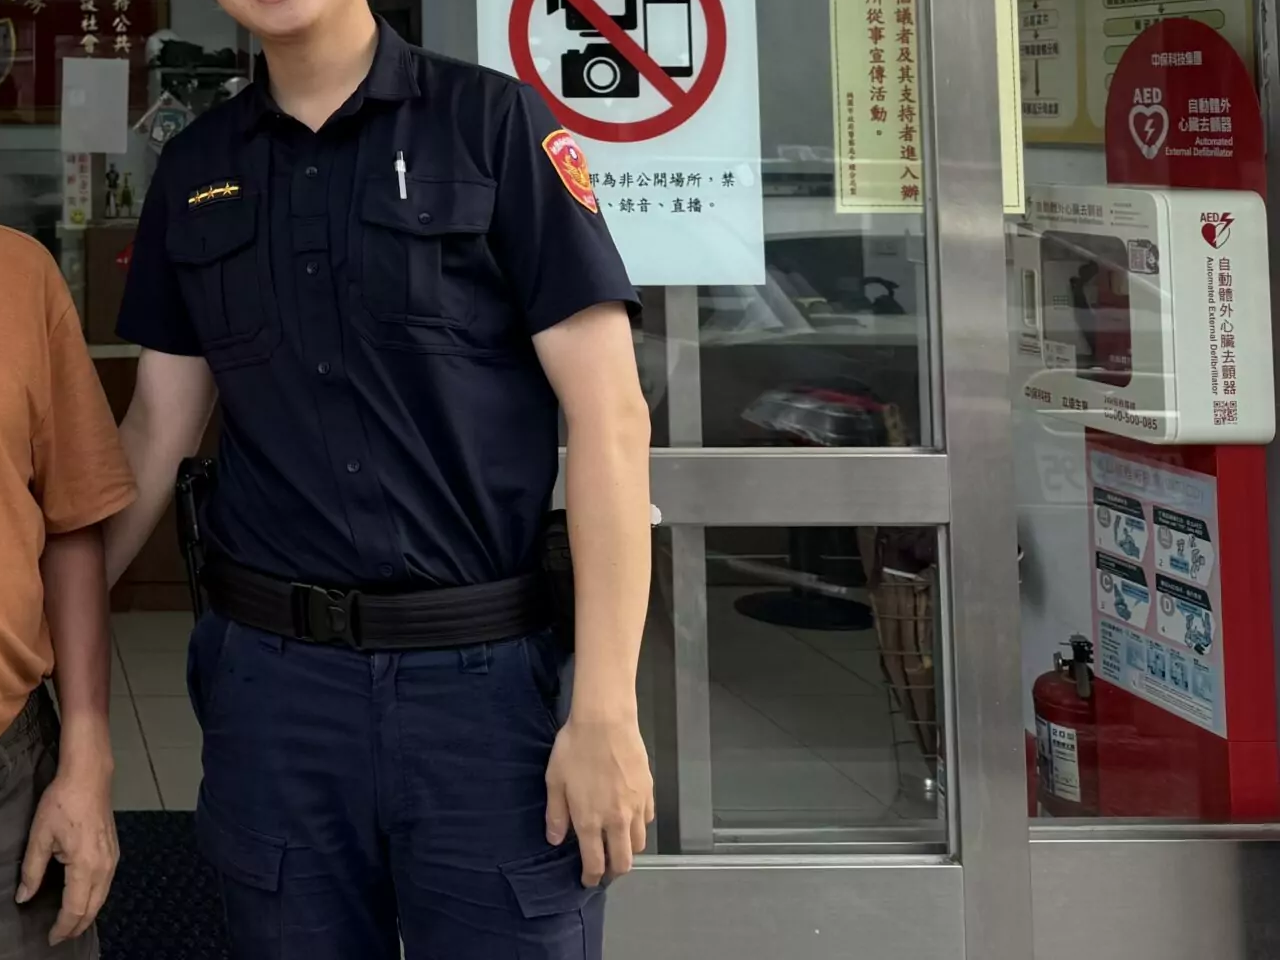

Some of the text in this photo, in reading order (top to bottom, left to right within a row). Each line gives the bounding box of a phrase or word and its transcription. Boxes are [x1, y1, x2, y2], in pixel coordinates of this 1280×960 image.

[1133, 86, 1163, 104] AED
[1188, 97, 1232, 114] 自動體外
[1178, 116, 1233, 133] 心臟去顫器
[1195, 135, 1234, 147] Automated
[1165, 146, 1234, 158] External Defibrillator
[597, 197, 716, 214] 、錄音、直播。
[1200, 212, 1220, 223] AED
[1206, 256, 1220, 396] Automated External Defibrillator
[1218, 256, 1237, 395] 自動體外心臟去顫器
